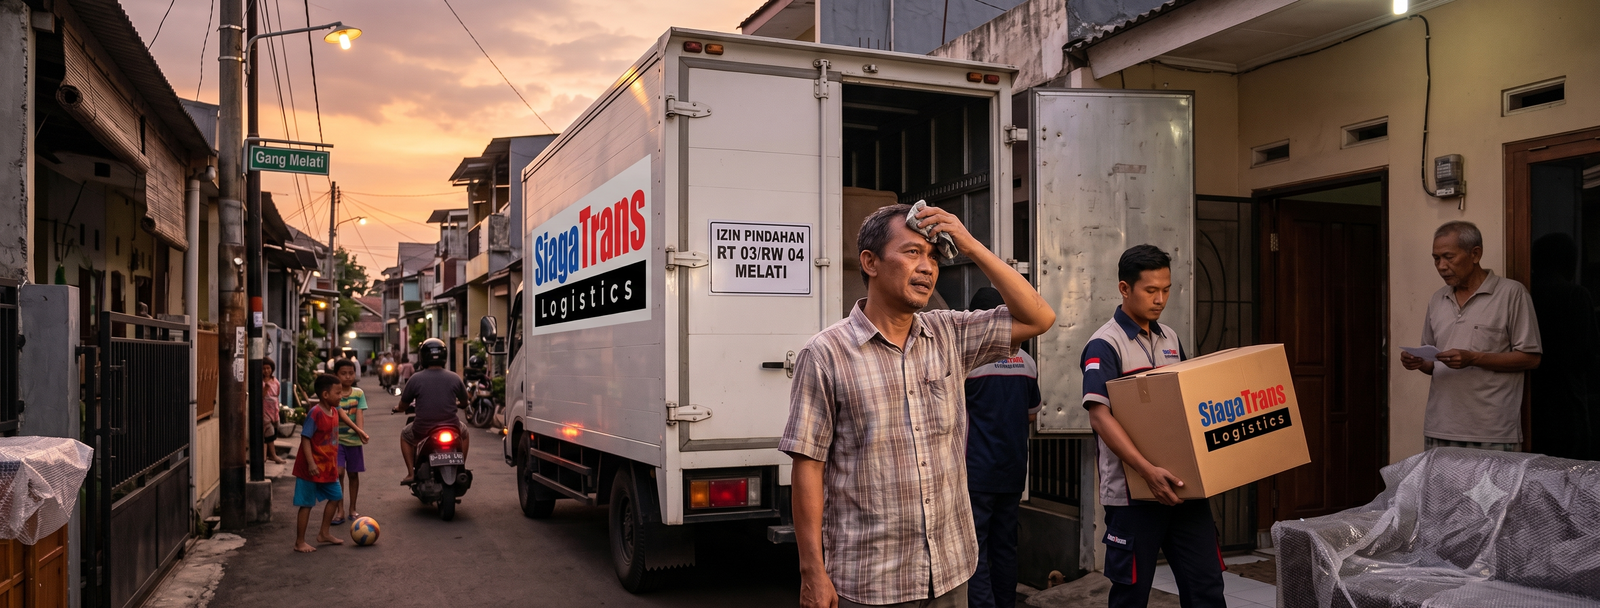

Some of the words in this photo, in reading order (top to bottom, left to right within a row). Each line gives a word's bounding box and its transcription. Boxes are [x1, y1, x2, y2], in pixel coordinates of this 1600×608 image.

[255, 151, 286, 168] Gang
[289, 153, 324, 168] Melati
[535, 189, 646, 287] SiagaTrans
[716, 228, 740, 241] IZIN
[744, 229, 804, 243] PINDAHAN
[717, 245, 736, 260] RT
[740, 246, 784, 261] 03/RW
[787, 247, 804, 261] 04
[735, 264, 787, 279] MELATI
[541, 280, 632, 319] Logistics
[1198, 384, 1287, 427] SiagaTrans
[1212, 414, 1285, 445] Logistics
